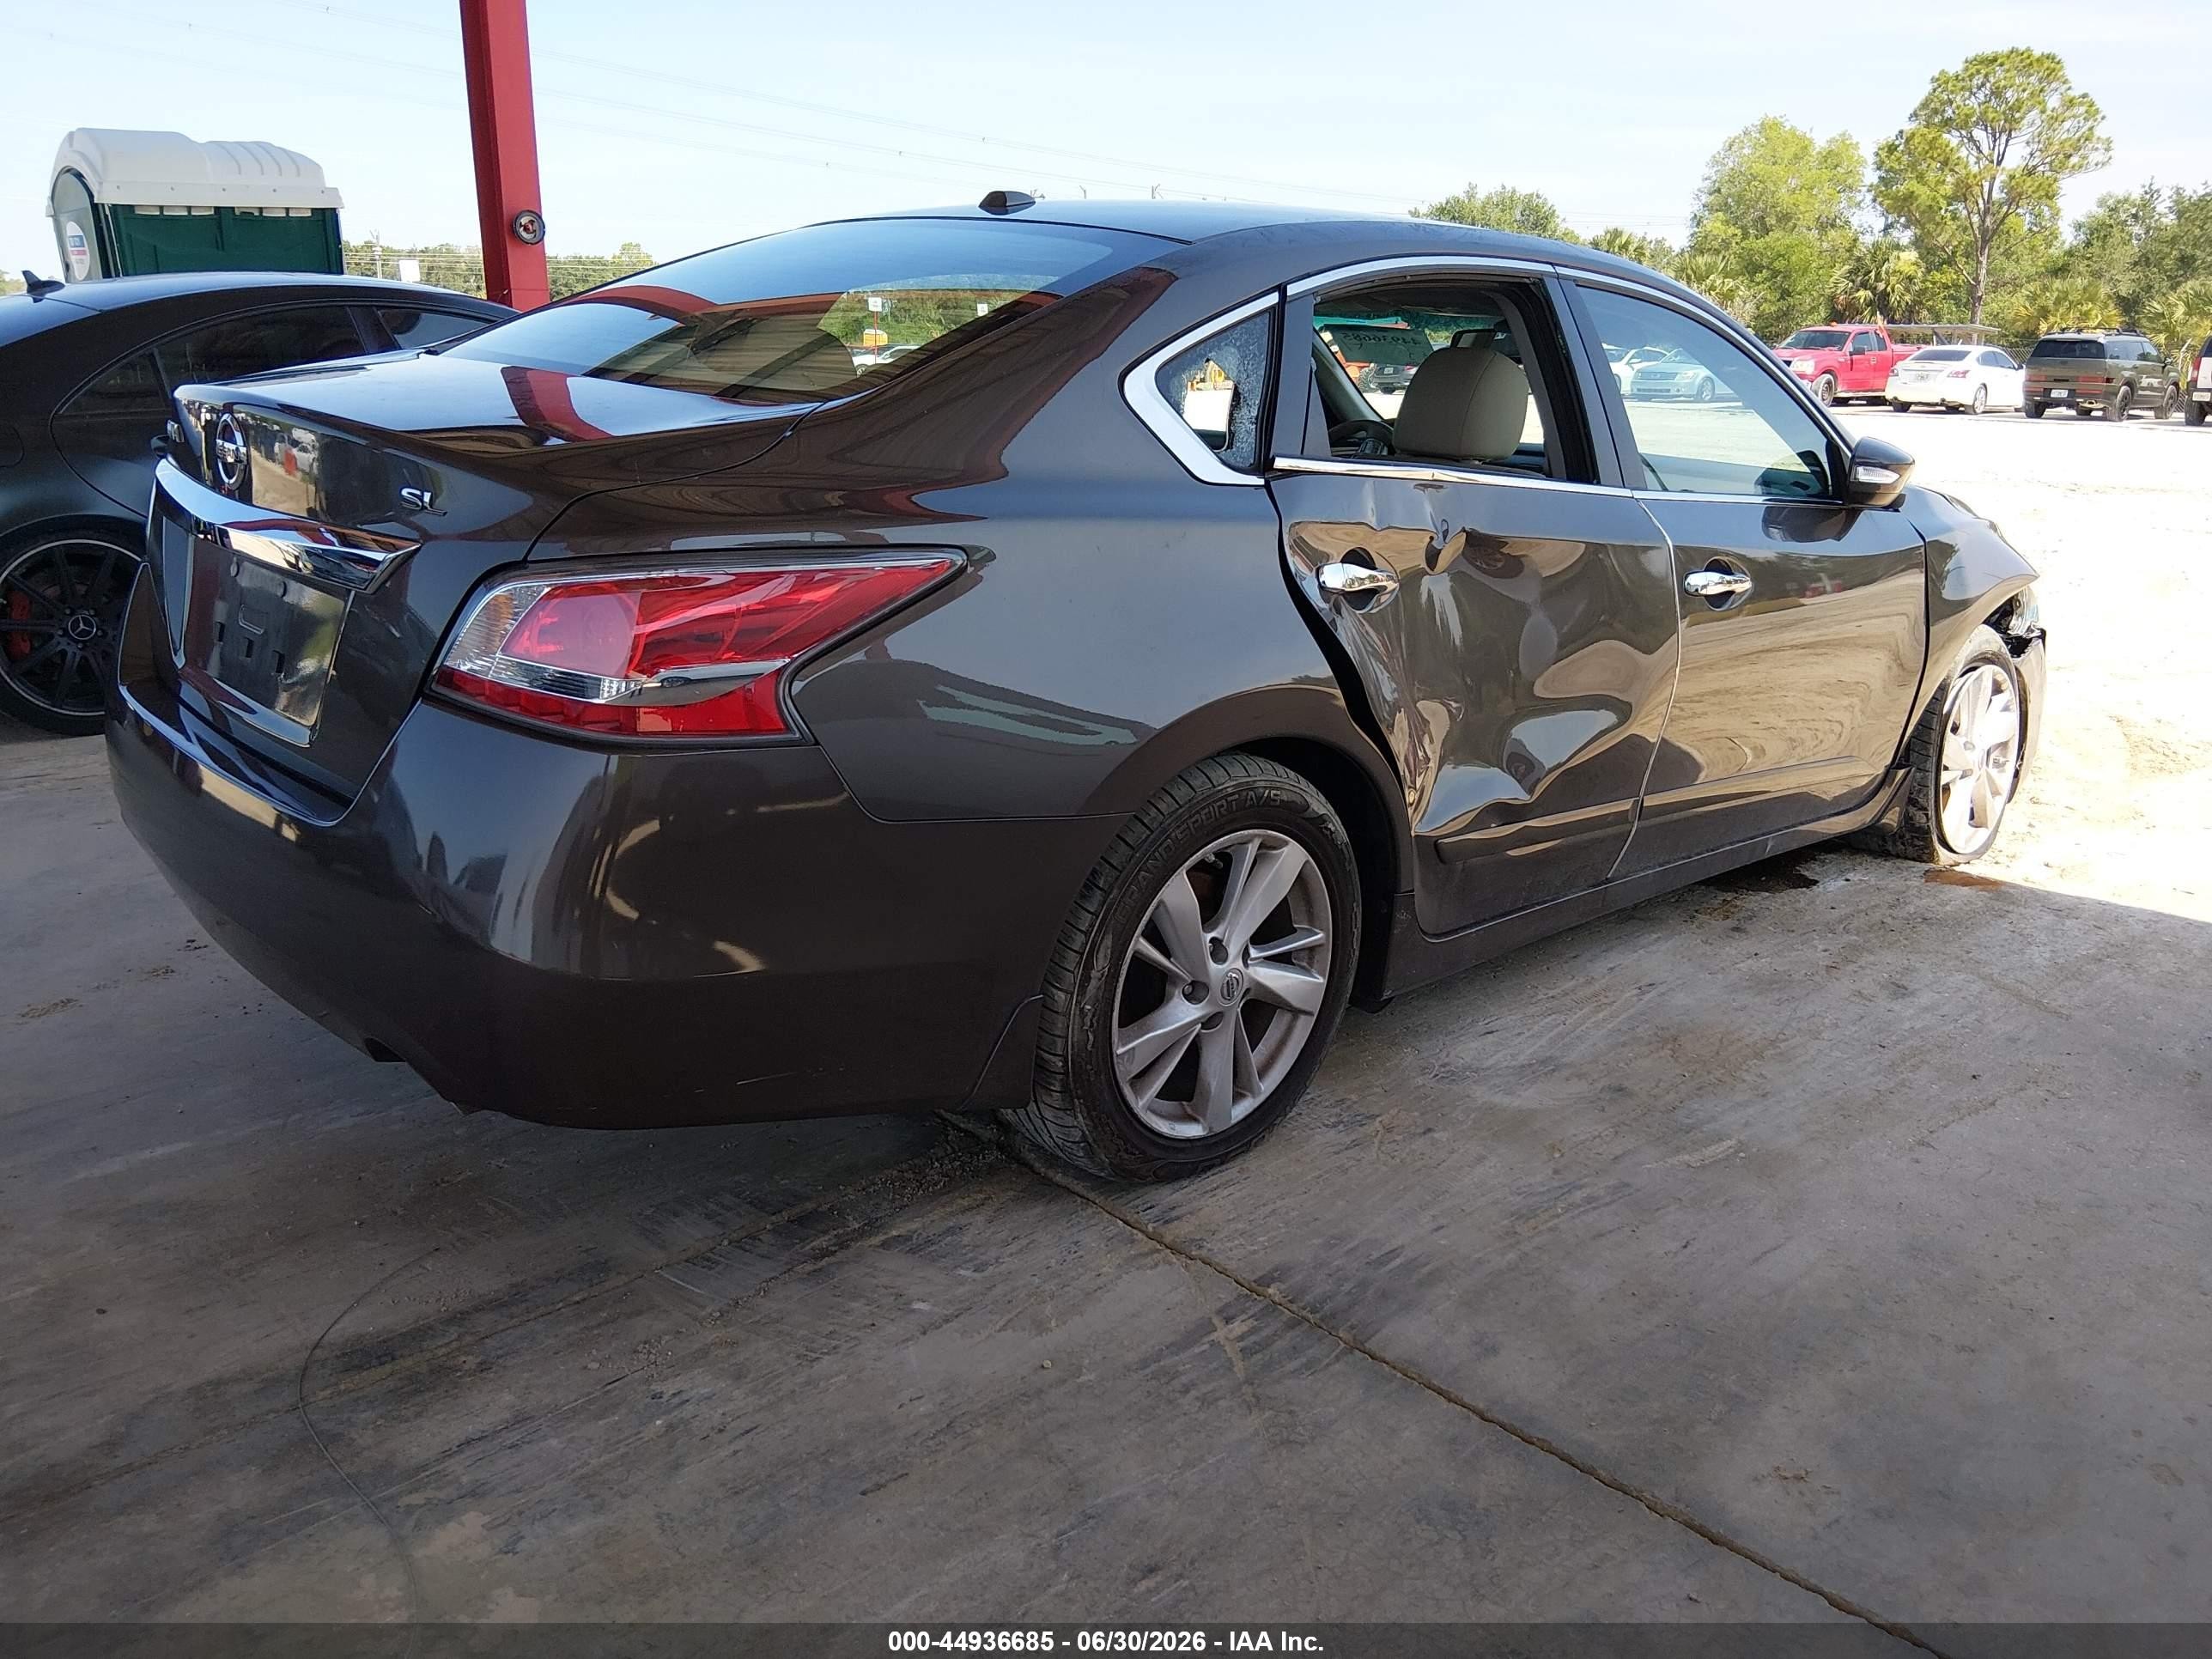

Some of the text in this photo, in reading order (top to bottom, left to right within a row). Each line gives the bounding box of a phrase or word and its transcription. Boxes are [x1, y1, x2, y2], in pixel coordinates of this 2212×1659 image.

[398, 487, 448, 516] SL
[1176, 794, 1239, 841] SPORT
[1245, 788, 1281, 807] A/S
